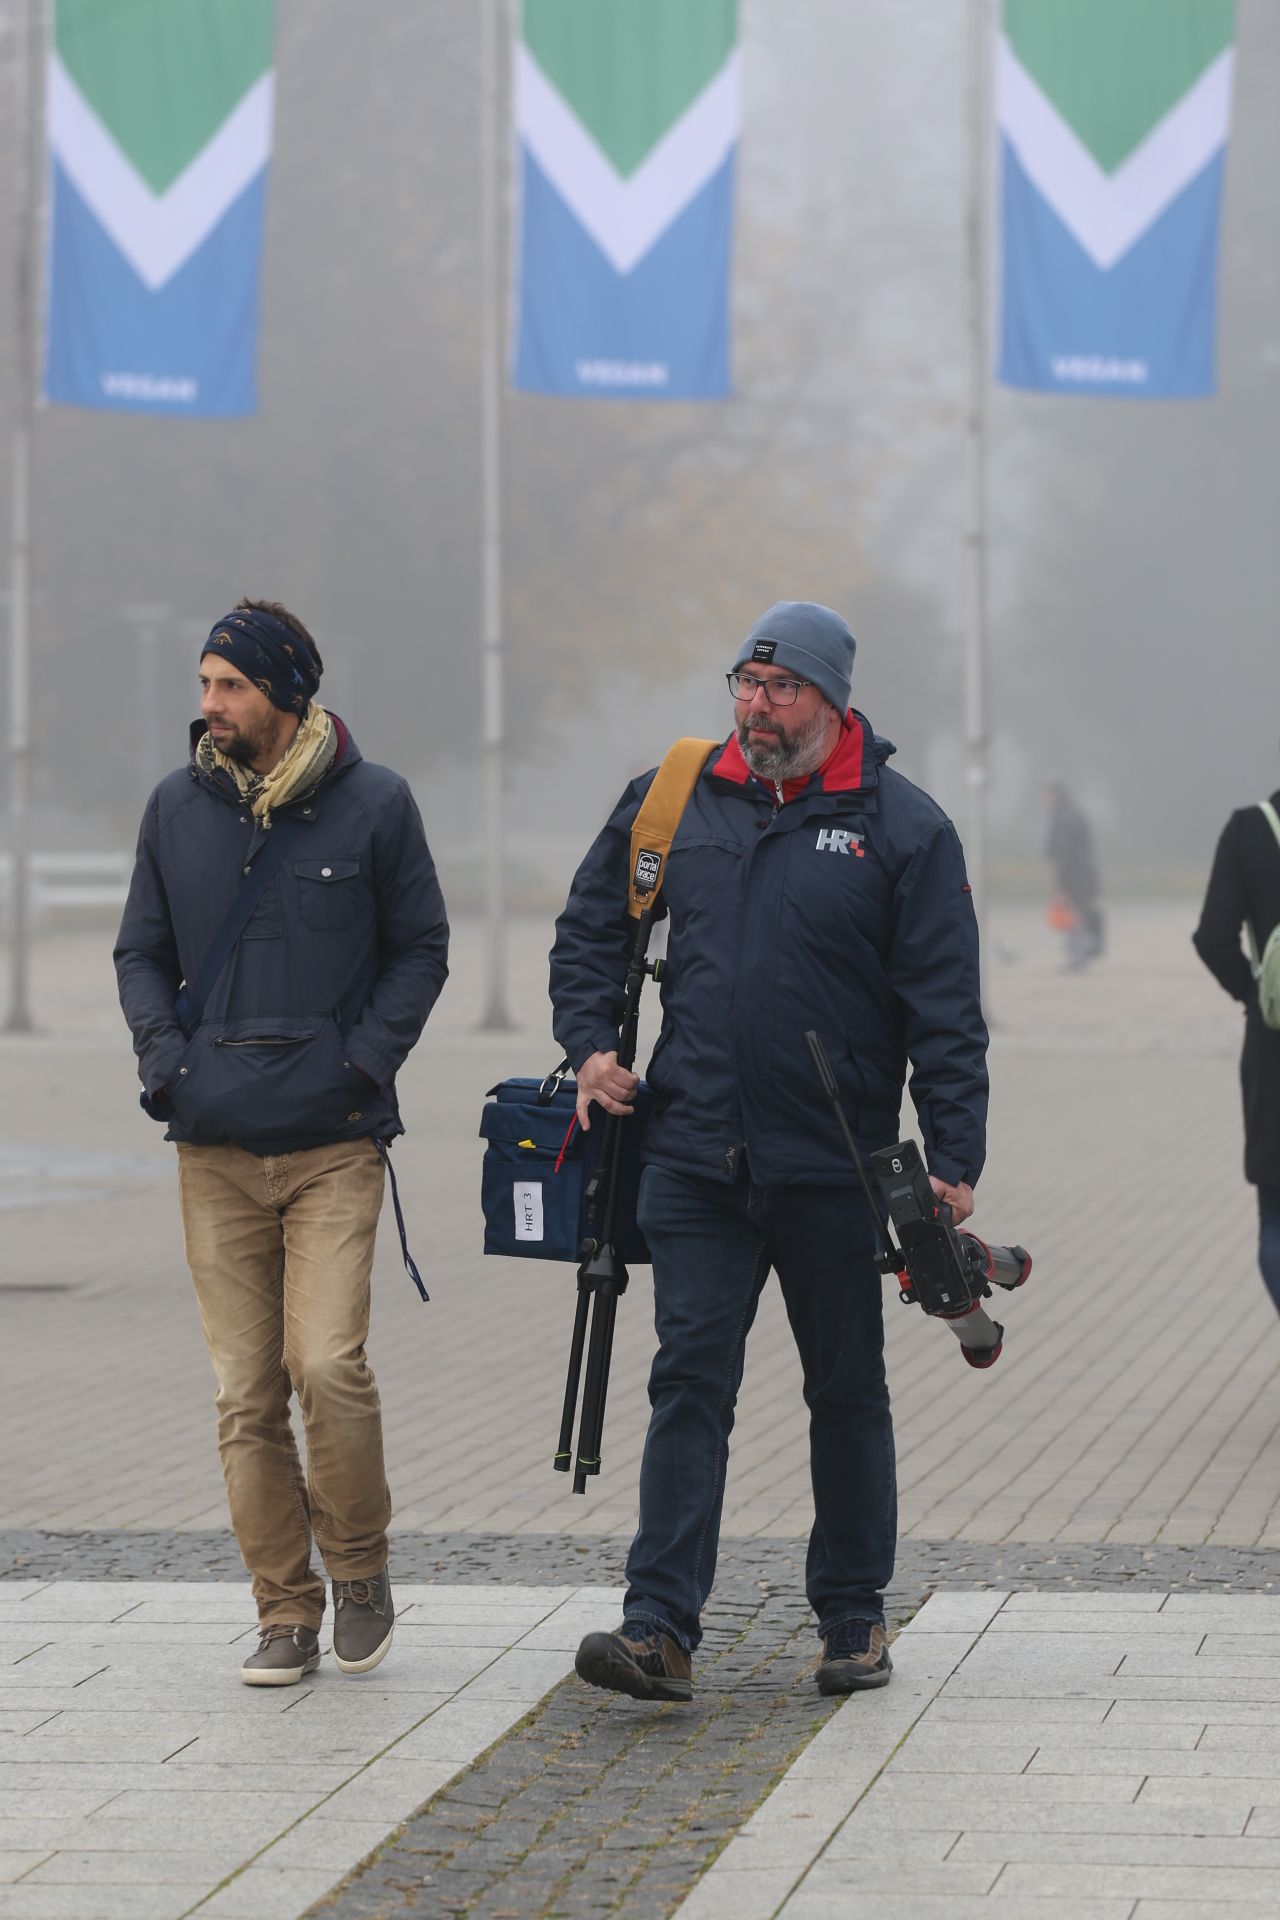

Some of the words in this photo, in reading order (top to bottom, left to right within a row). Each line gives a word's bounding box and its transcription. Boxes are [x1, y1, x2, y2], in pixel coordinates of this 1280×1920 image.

[576, 361, 668, 384] VEGAN
[1051, 356, 1147, 382] VEGAN
[101, 374, 197, 400] VEGAN
[816, 829, 865, 856] HRT
[524, 1204, 533, 1231] HRT
